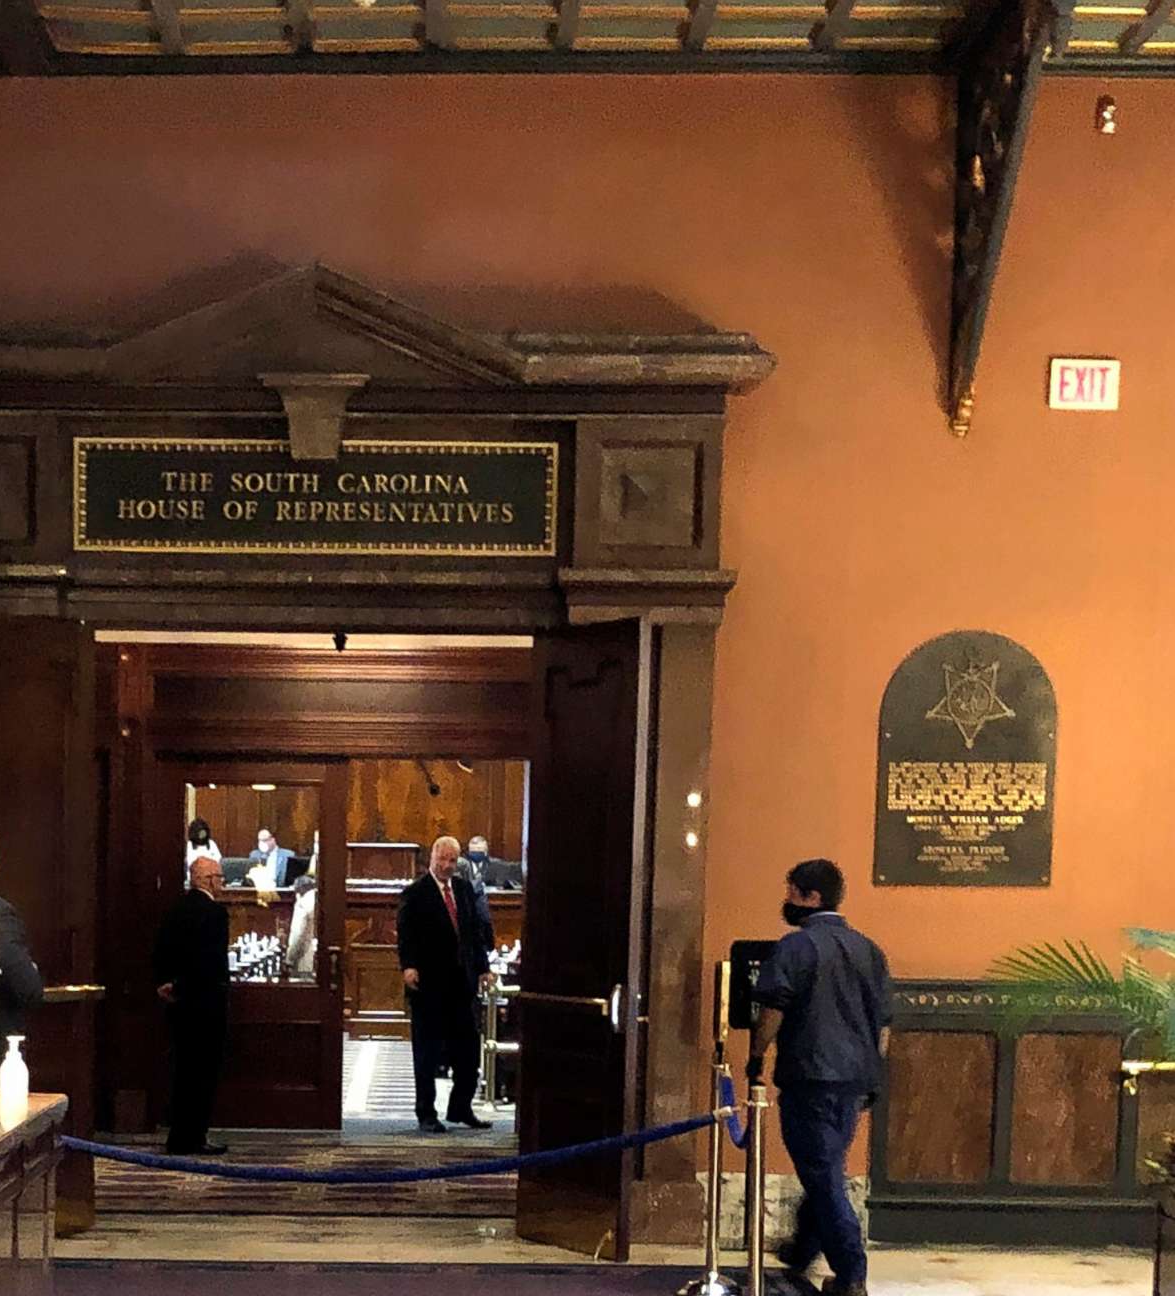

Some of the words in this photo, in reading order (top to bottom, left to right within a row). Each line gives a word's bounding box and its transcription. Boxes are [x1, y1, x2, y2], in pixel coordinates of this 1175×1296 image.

[1059, 366, 1111, 402] EXIT
[161, 471, 214, 494] THE
[231, 472, 320, 495] SOUTH
[338, 472, 471, 496] CAROLINA
[117, 498, 206, 521] HOUSE
[223, 499, 259, 522] OF
[275, 499, 515, 525] REPRESENTATIVES
